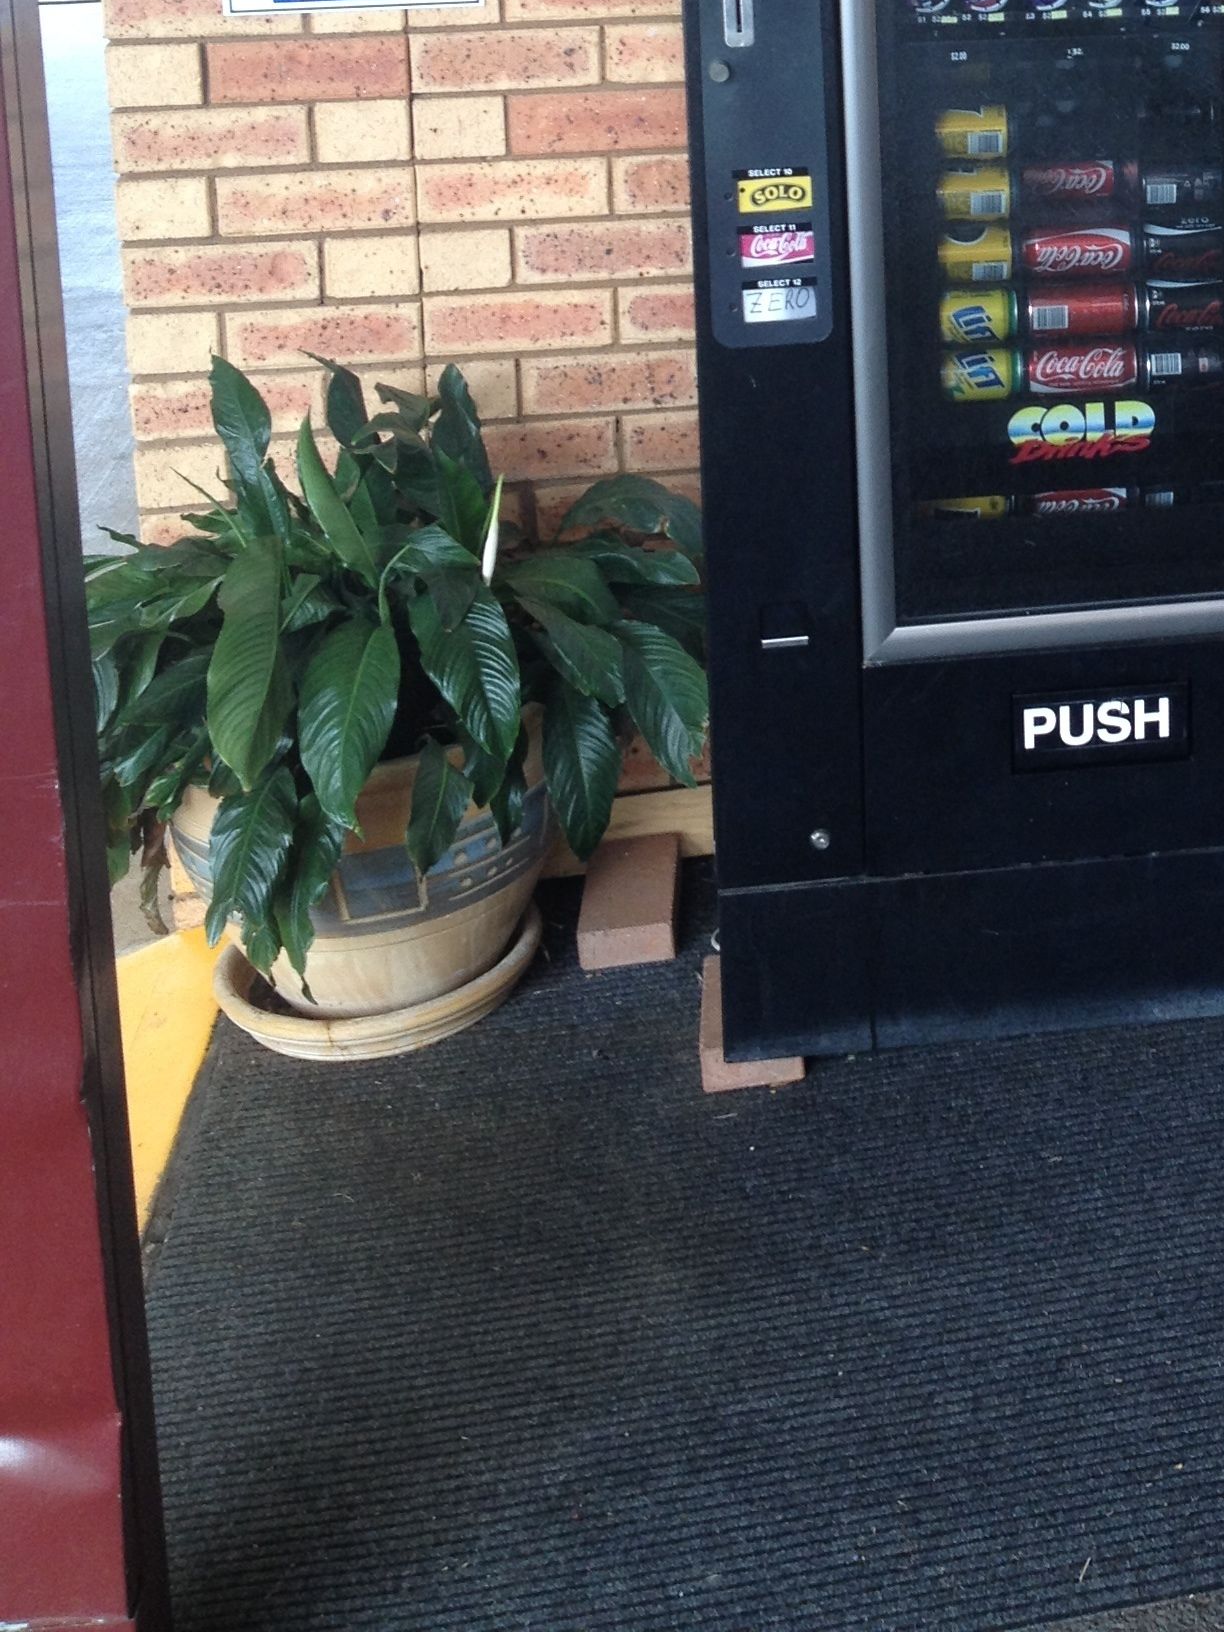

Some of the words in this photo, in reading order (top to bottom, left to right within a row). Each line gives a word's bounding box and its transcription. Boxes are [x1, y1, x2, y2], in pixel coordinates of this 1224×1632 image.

[748, 168, 781, 177] SELECT
[783, 168, 793, 176] 10
[754, 184, 804, 204] SOLO
[753, 224, 787, 233] SELECT
[757, 279, 791, 288] SELECT
[792, 279, 802, 287] 12
[746, 286, 810, 314] ZERO
[1036, 347, 1127, 381] Coca-Cola
[1007, 400, 1156, 447] COLD
[1023, 697, 1170, 750] PUSH
